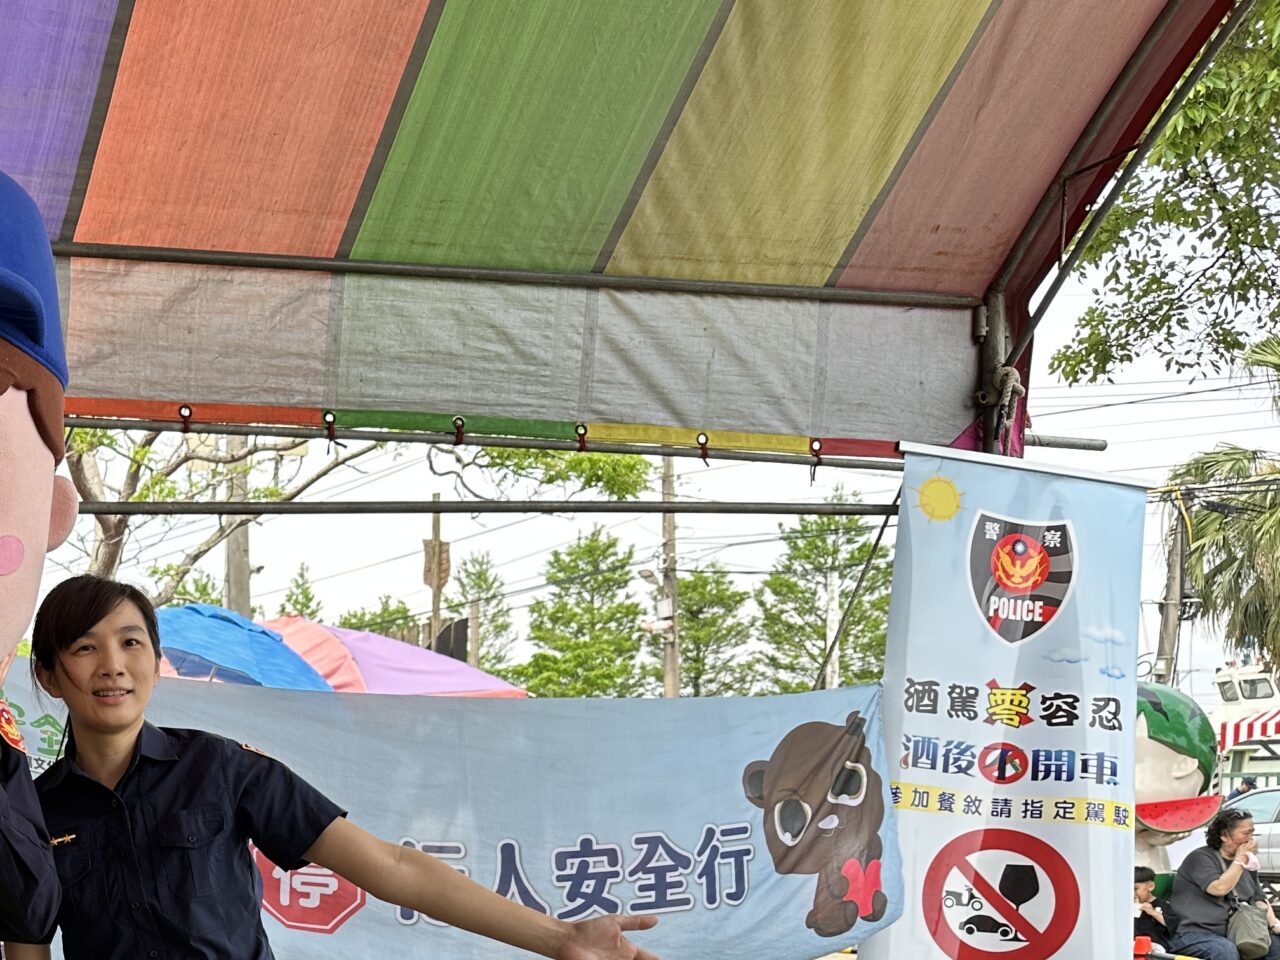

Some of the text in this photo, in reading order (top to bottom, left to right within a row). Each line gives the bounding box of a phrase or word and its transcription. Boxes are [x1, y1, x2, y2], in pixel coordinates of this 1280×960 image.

[984, 521, 1061, 548] 警 察
[989, 595, 1043, 622] POLICE
[903, 676, 1123, 732] 酒駕零容忍
[901, 733, 1120, 786] 酒後不開車
[272, 863, 339, 908] 停
